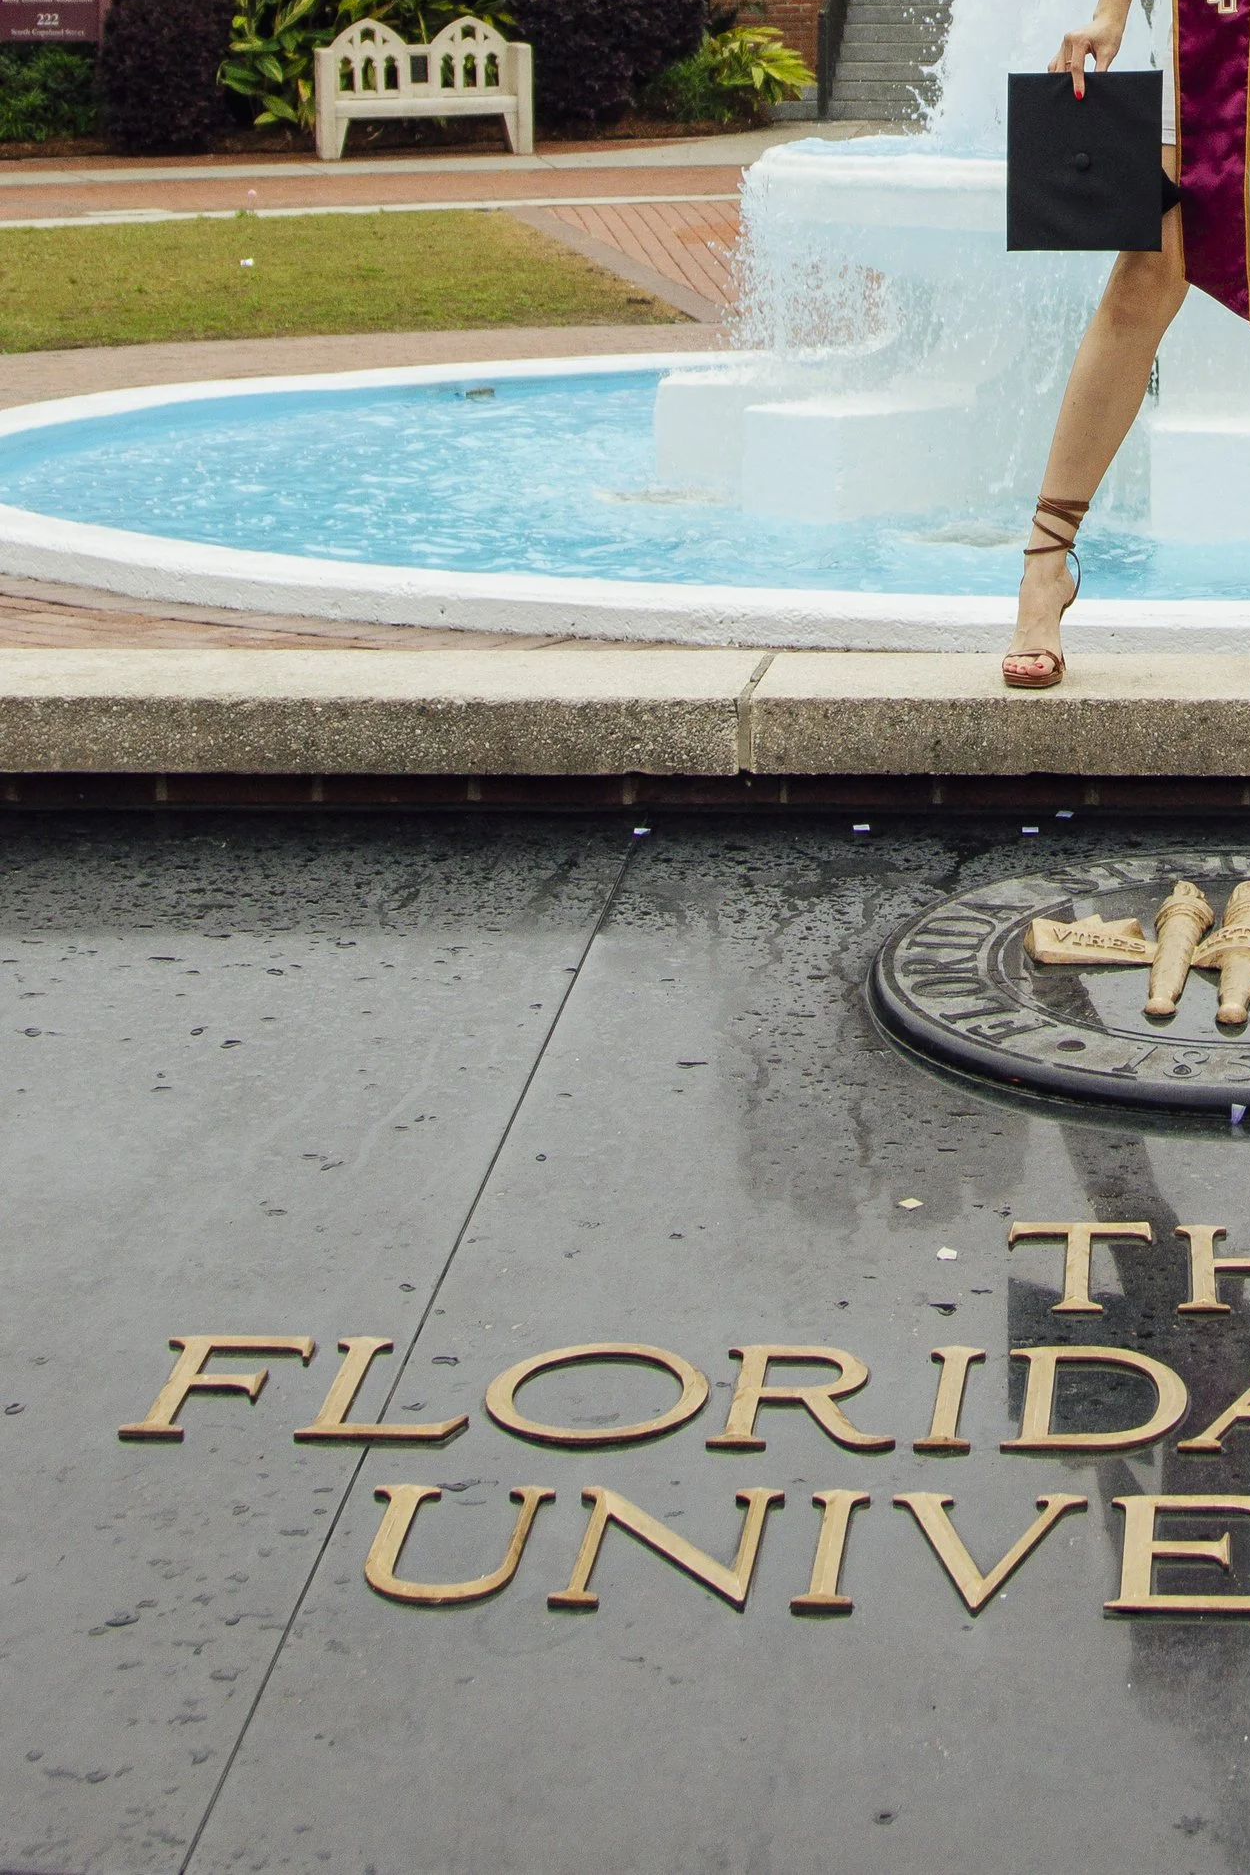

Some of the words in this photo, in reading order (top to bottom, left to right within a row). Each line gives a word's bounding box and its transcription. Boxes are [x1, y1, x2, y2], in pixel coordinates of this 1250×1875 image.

[36, 13, 59, 25] 222
[1053, 926, 1146, 954] VIRES
[901, 901, 1056, 1044] FLORIDA
